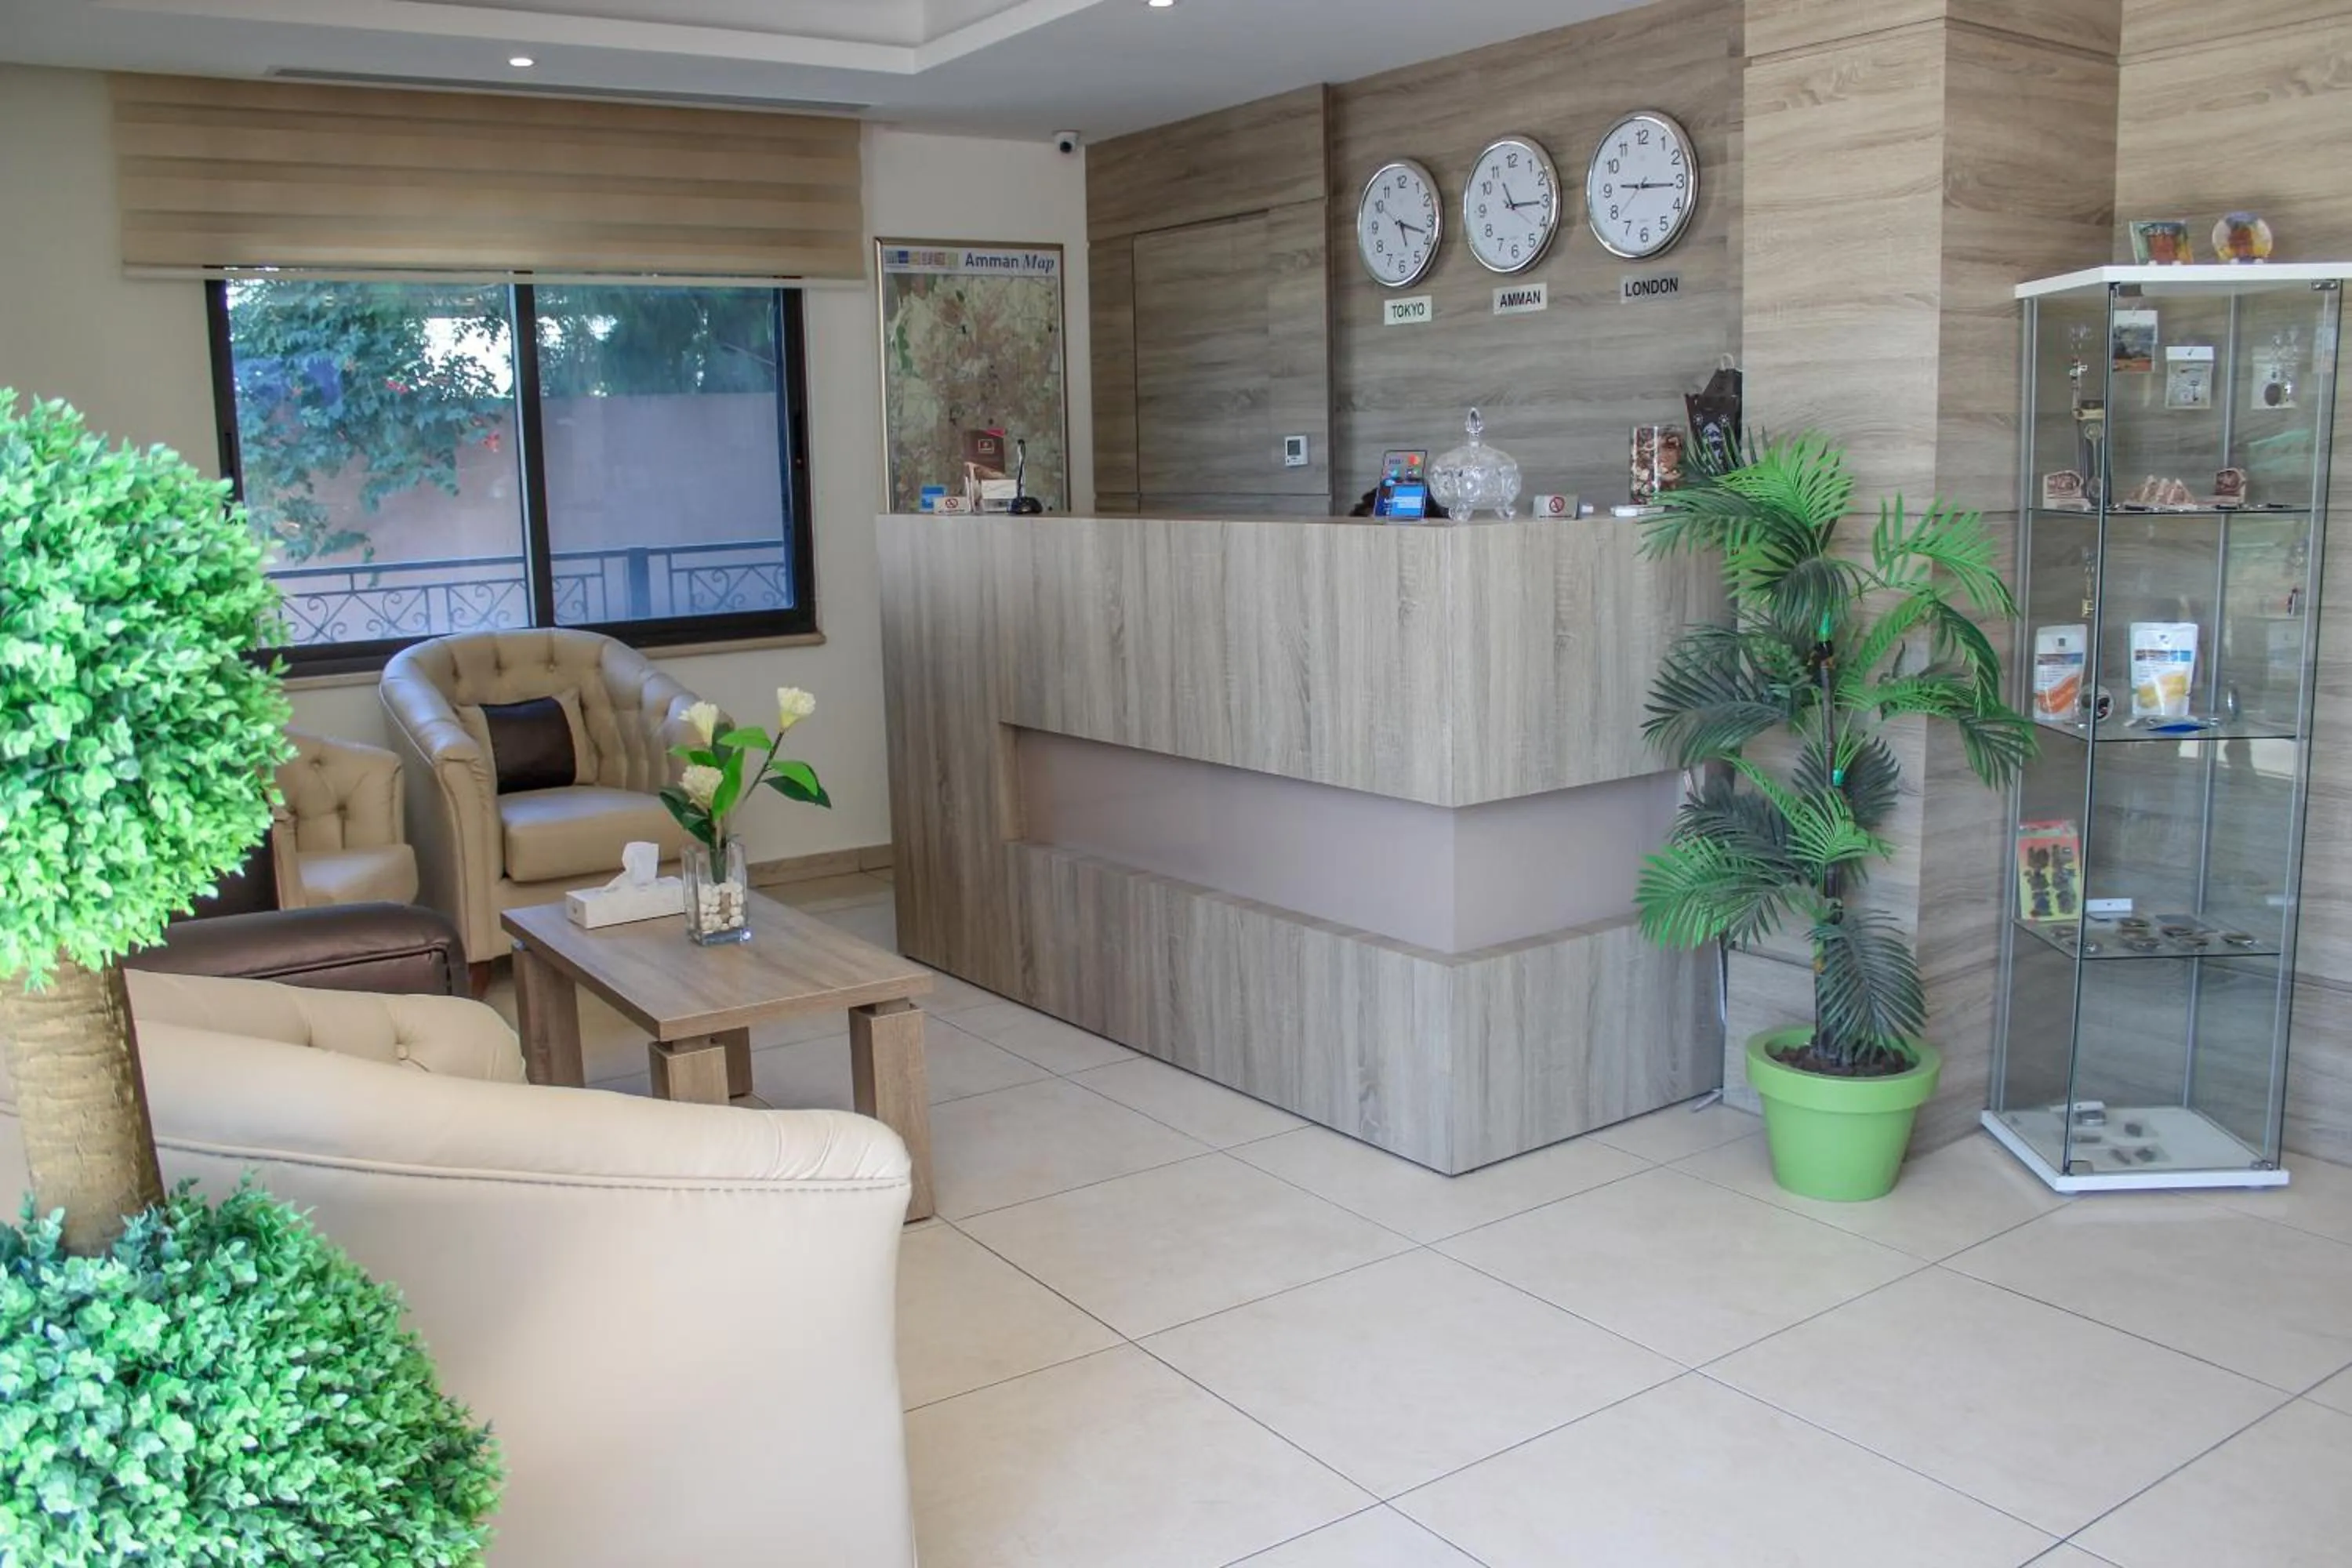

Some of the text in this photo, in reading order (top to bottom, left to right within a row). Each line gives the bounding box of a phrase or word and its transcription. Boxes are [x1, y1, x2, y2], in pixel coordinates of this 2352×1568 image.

[1635, 129, 1649, 145] 12
[1618, 143, 1628, 157] 11
[1506, 153, 1518, 168] 12
[1671, 151, 1680, 165] 2
[1491, 166, 1500, 179] 11
[1607, 159, 1619, 174] 10
[1397, 175, 1407, 189] 12
[1537, 172, 1545, 185] 2
[1675, 175, 1684, 189] 3
[1384, 187, 1390, 199] 11
[1481, 182, 1492, 196] 10
[1603, 183, 1612, 198] 9
[1375, 201, 1384, 213] 10
[1423, 194, 1430, 207] 2
[1541, 194, 1549, 208] 3
[1672, 198, 1681, 212] 4
[1479, 204, 1486, 218] 9
[1610, 205, 1618, 220] 8
[1372, 221, 1378, 234] 9
[1426, 215, 1433, 228] 3
[1540, 216, 1547, 230] 4
[1624, 220, 1631, 235] 7
[1660, 216, 1668, 231] 5
[1485, 223, 1493, 237] 8
[1640, 227, 1649, 242] 6
[1377, 240, 1383, 253] 8
[1497, 238, 1504, 251] 7
[1528, 233, 1536, 248] 5
[1414, 251, 1421, 263] 5
[1512, 245, 1519, 258] 6
[965, 252, 1018, 268] Amman
[1023, 254, 1054, 274] Map
[1386, 254, 1392, 267] 7
[1399, 260, 1405, 273] 6
[1625, 278, 1678, 296] LONDON
[1500, 290, 1541, 307] AMMAN
[1392, 303, 1425, 318] TOKYO
